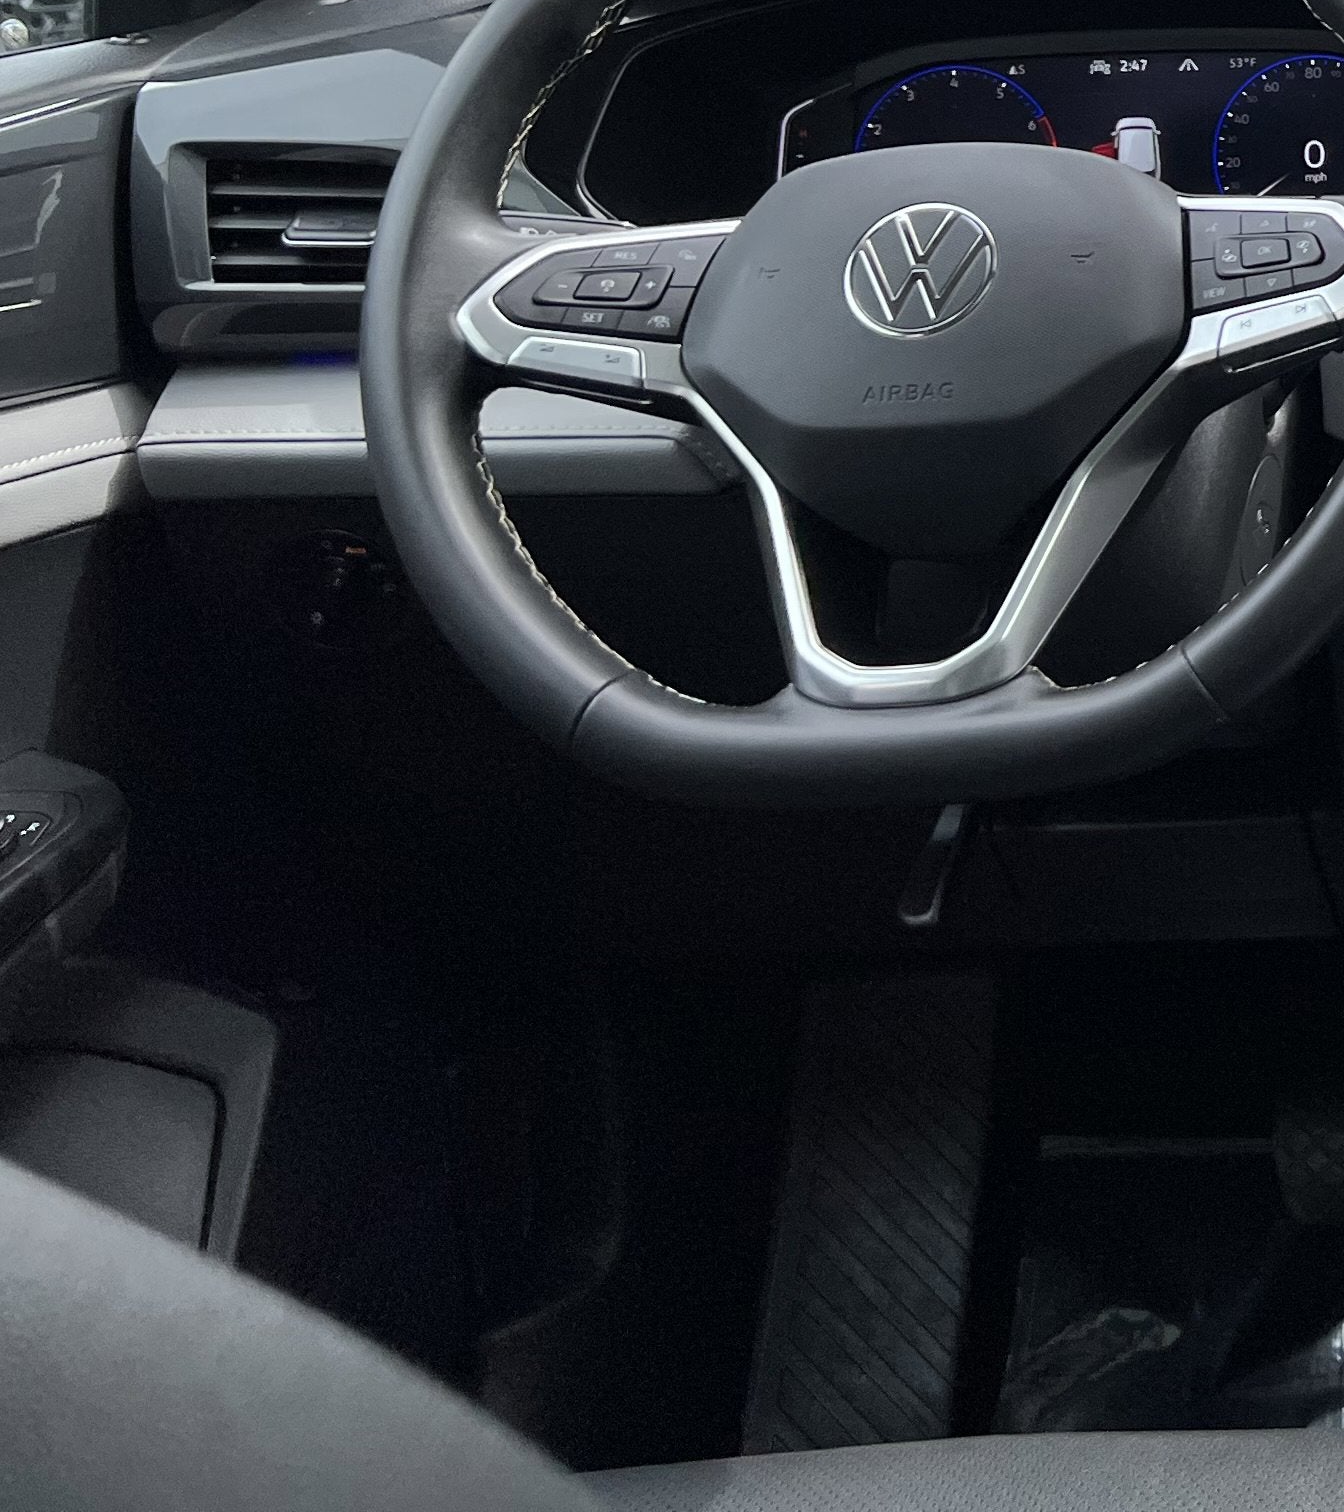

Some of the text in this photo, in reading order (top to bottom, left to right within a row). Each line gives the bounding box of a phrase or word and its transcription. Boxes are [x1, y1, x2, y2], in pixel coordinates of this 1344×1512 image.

[1120, 58, 1148, 72] 2:47
[1304, 66, 1322, 79] 80
[1264, 81, 1280, 93] 60
[906, 89, 915, 102] 3
[996, 88, 1004, 100] 5
[1234, 113, 1250, 125] 40
[873, 124, 883, 136] 2
[1303, 140, 1326, 168] 0
[1225, 156, 1241, 169] 20
[1305, 172, 1328, 184] mph
[614, 251, 637, 261] RES
[1202, 286, 1227, 299] VIEW
[582, 312, 605, 324] SET
[862, 382, 955, 405] AIRBAG
